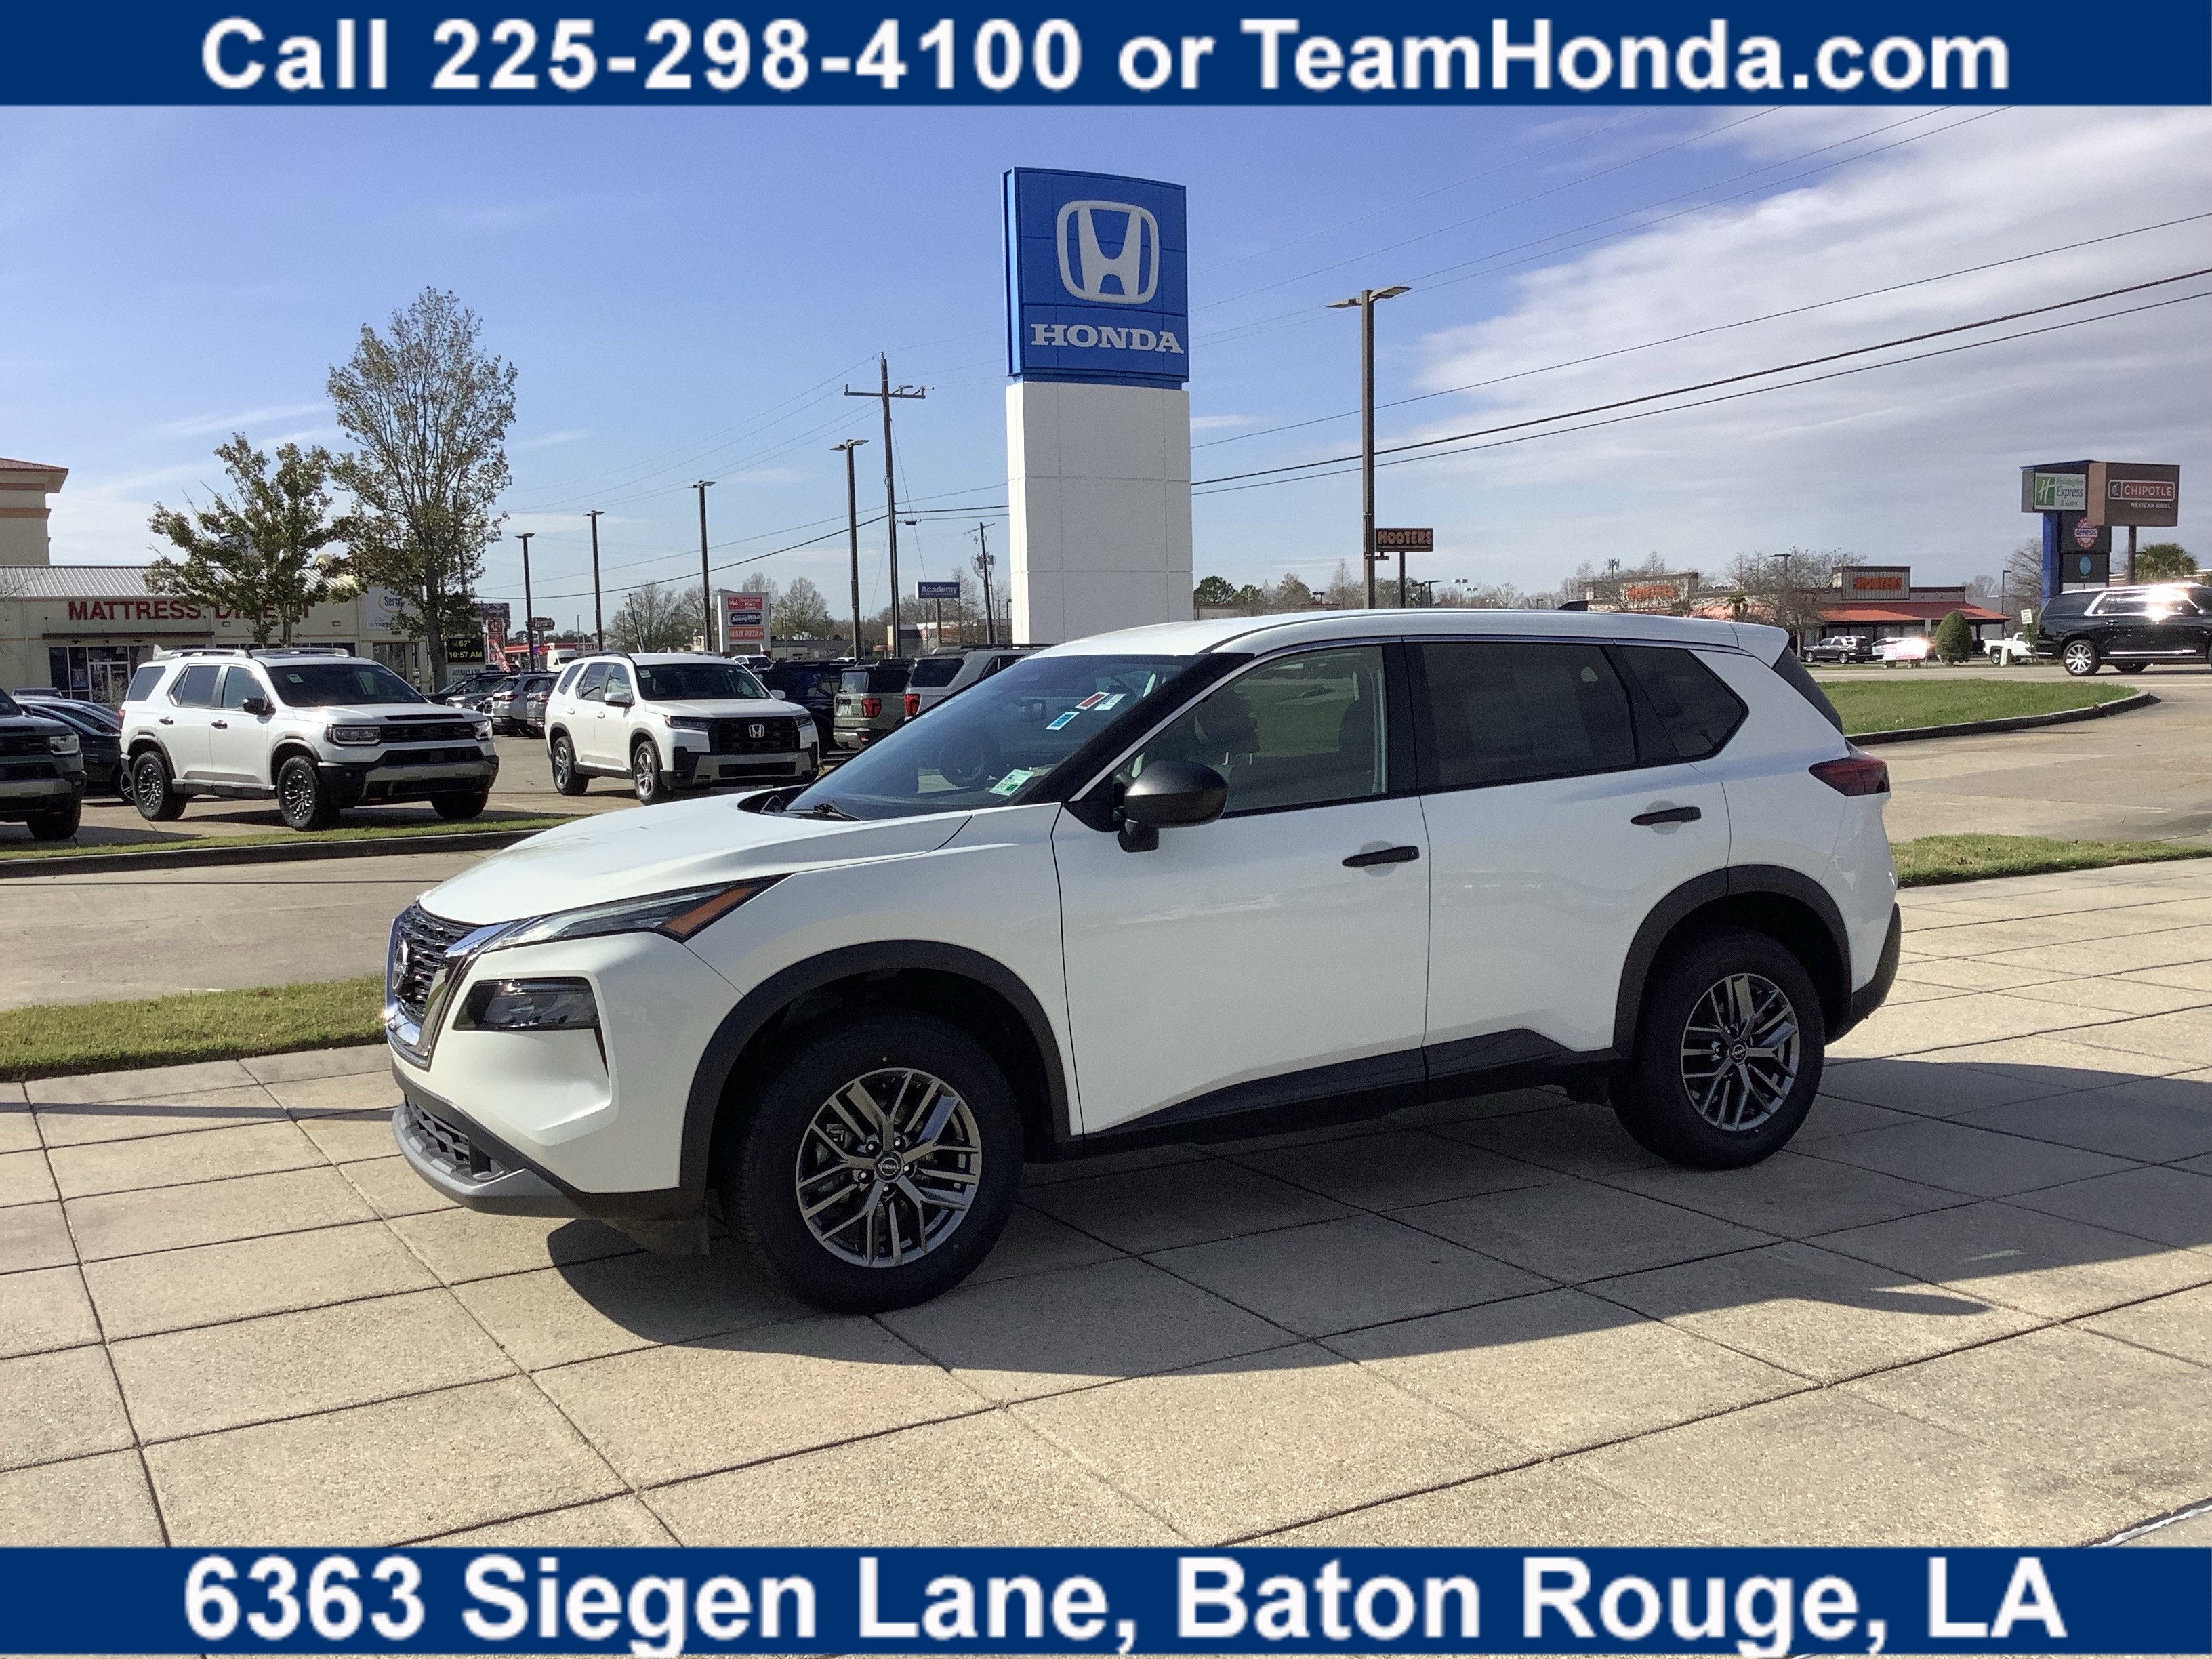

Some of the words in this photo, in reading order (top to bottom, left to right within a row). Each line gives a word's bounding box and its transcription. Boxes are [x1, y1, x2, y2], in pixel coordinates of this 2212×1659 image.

[1030, 323, 1185, 354] HONDA
[2056, 485, 2083, 498] Express
[2124, 485, 2172, 496] CHIPOTLE
[1377, 531, 1432, 544] HOOTERS
[921, 585, 958, 595] Academy
[68, 600, 201, 620] MATTRESS
